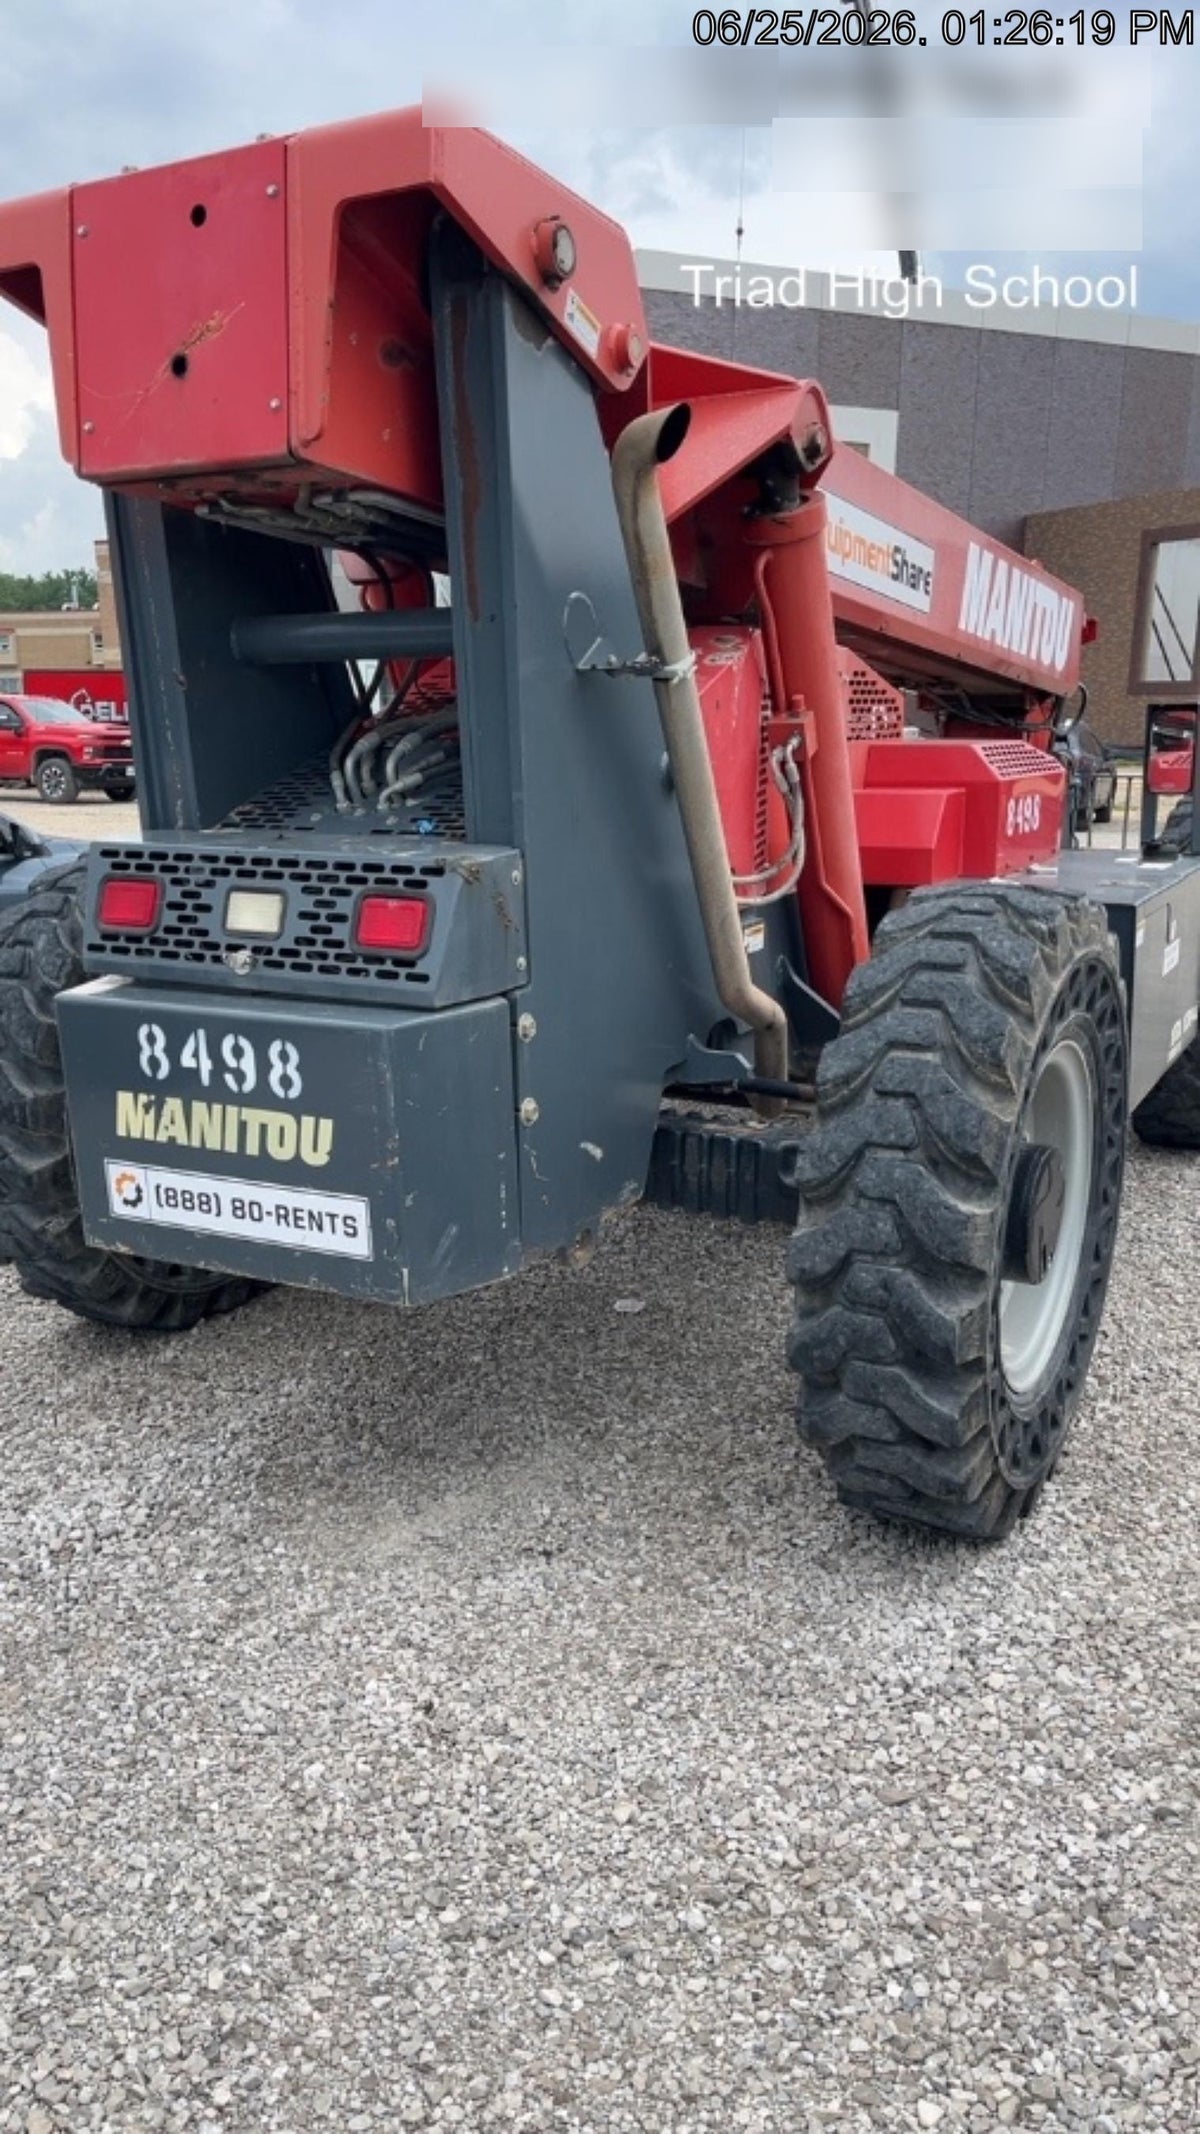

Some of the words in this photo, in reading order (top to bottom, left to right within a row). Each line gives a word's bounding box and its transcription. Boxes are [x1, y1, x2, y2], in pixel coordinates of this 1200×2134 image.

[826, 516, 932, 596] uipmentShare
[958, 541, 1075, 672] MANITOU
[1006, 793, 1041, 837] 8498
[137, 1023, 303, 1099] 8498
[116, 1090, 334, 1168] MANITOU
[155, 1183, 222, 1217] (888)
[231, 1197, 359, 1239] 80-RENTS
